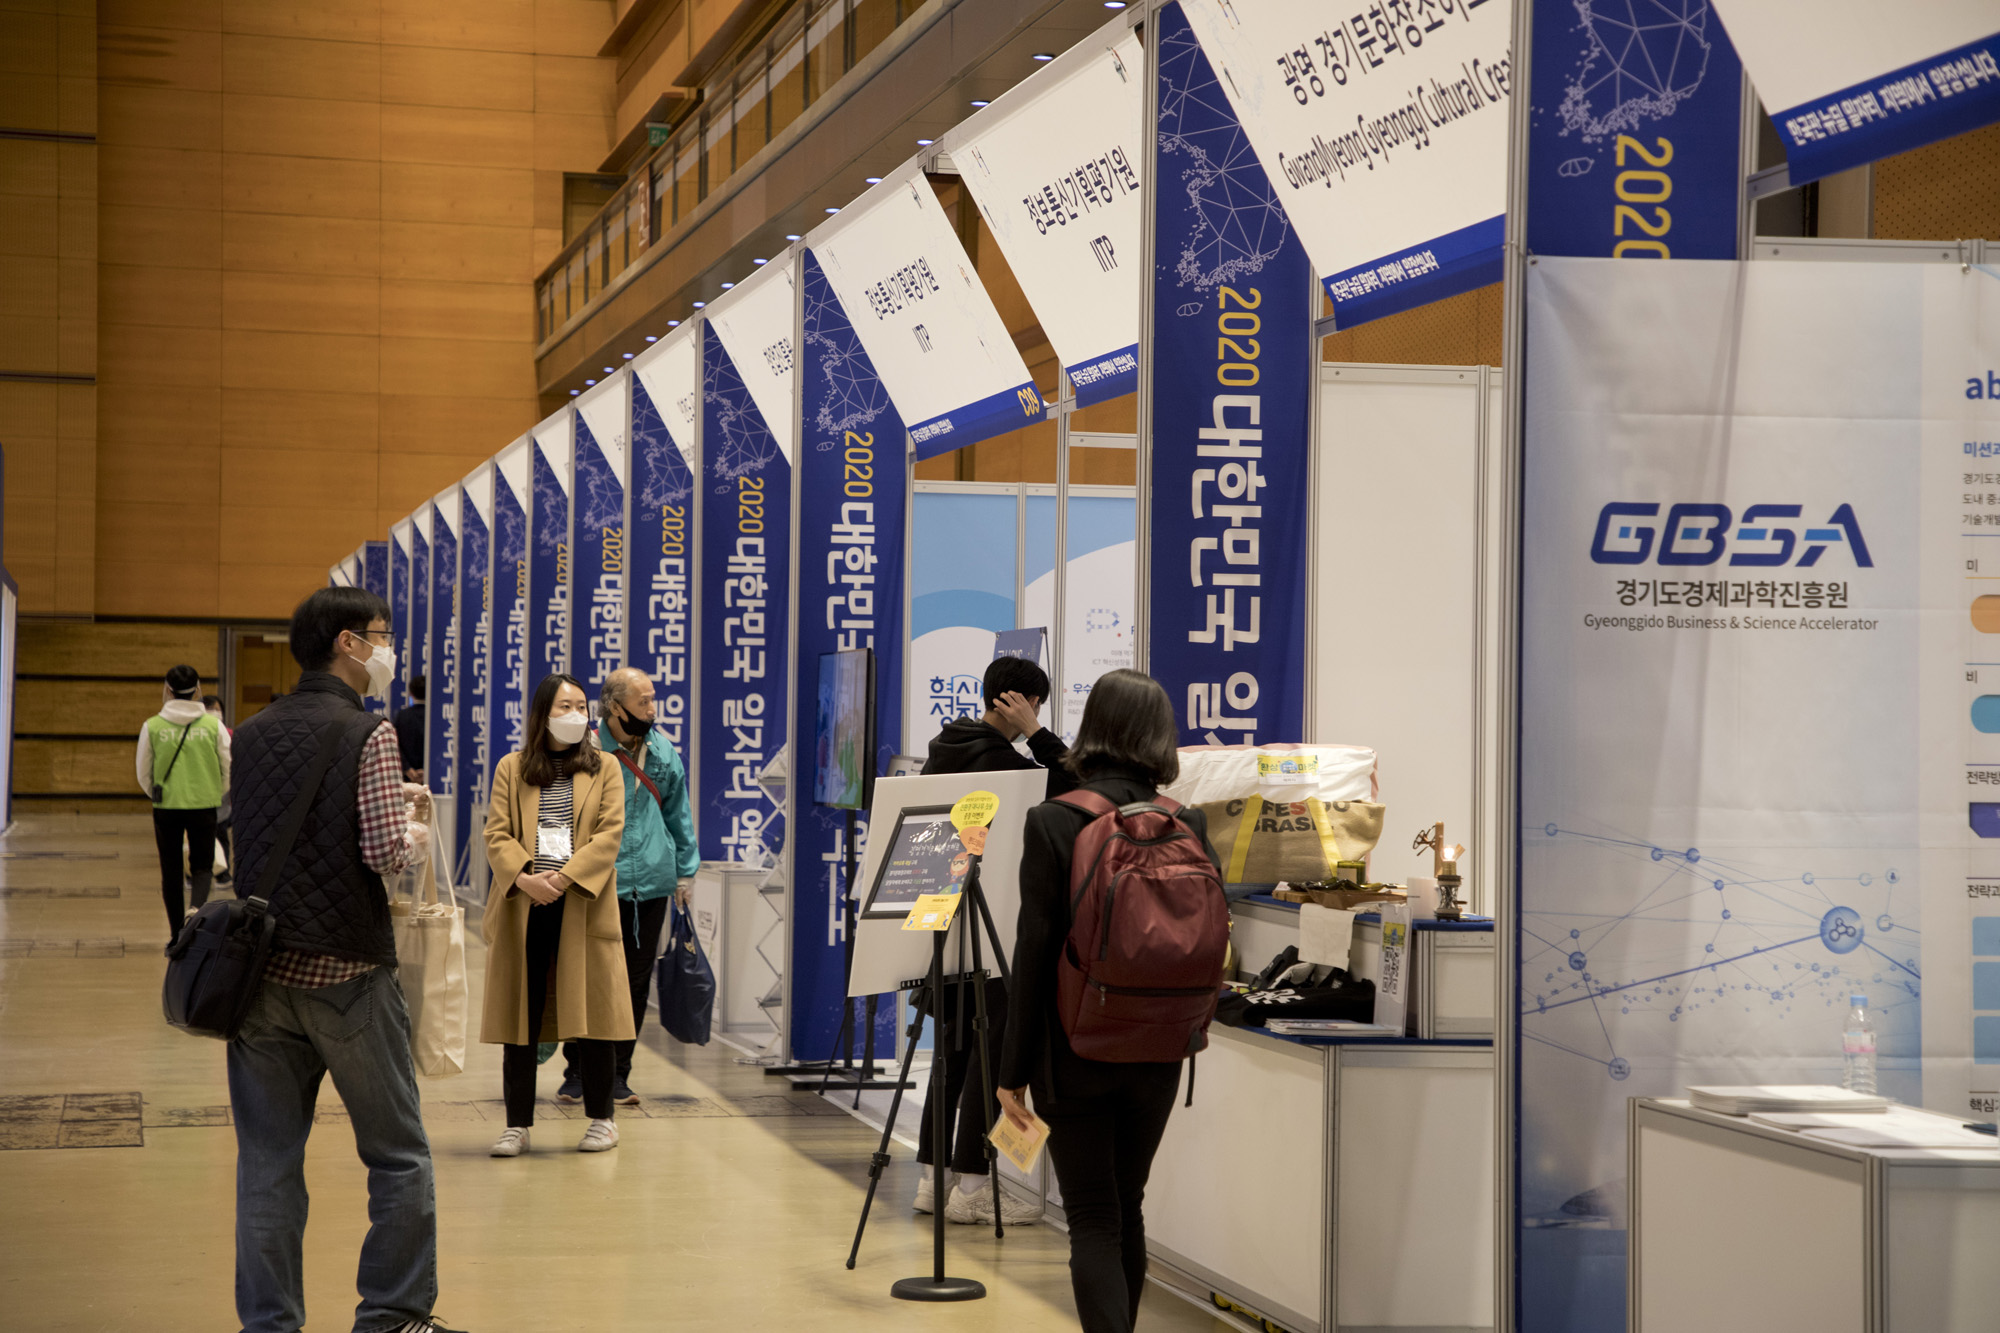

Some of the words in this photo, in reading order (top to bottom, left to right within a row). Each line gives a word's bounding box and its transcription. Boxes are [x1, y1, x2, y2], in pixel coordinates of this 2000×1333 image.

[1276, 43, 1325, 106] 광명
[1279, 134, 1374, 190] GwangMyeong
[1357, 90, 1430, 163] Gyeonggi
[1417, 62, 1485, 128] Cultural
[1473, 50, 1511, 103] Crea
[1022, 145, 1140, 235] 정보통신기획평가원
[1612, 134, 1674, 259] 2020
[865, 256, 939, 320] 정보통신기획평가원
[1017, 386, 1040, 416] C09
[1590, 501, 1874, 568] GBSA
[1584, 614, 1664, 631] Gyeonggido
[1667, 614, 1727, 630] Business
[1730, 616, 1740, 629] &
[1743, 616, 1796, 630] Science
[1800, 616, 1879, 630] Accelerator
[1616, 578, 1848, 608] 경기도경제과학진흥원
[722, 693, 765, 798] 일자리
[1226, 799, 1306, 817] CFES
